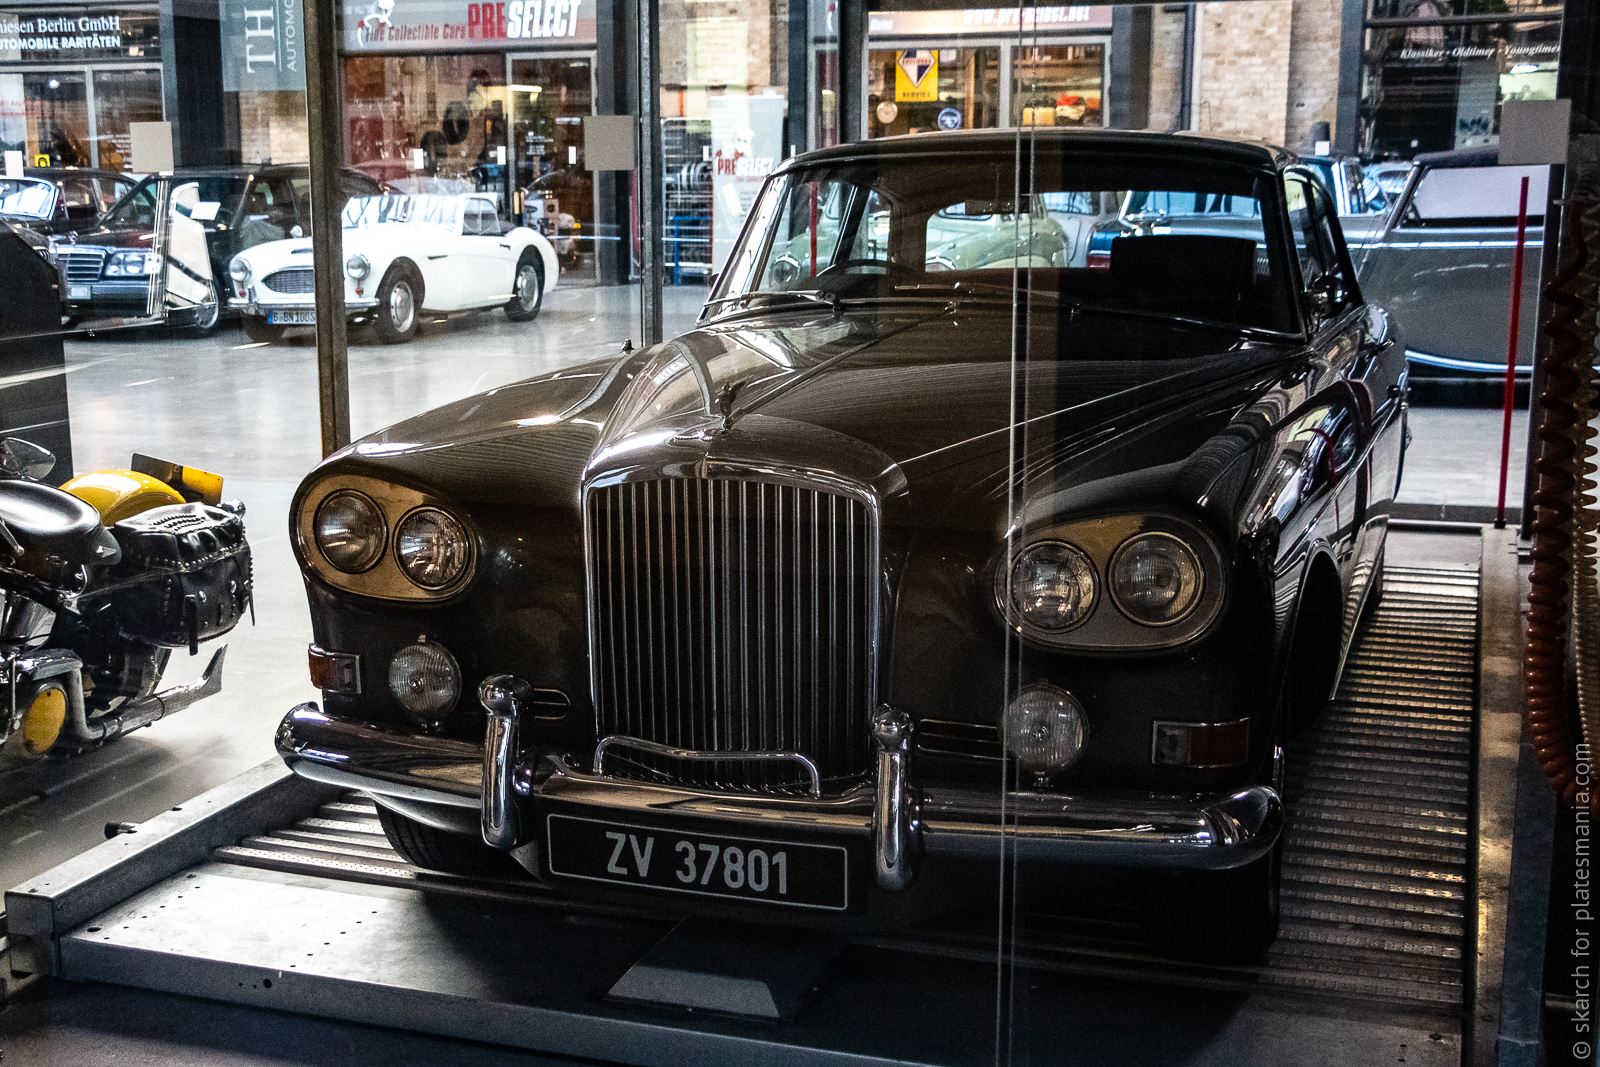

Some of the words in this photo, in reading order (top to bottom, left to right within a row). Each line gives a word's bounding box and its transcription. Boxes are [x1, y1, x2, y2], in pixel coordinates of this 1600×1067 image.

[37, 17, 76, 33] Berlin
[78, 15, 120, 32] GmbH
[388, 25, 440, 41] Collectible
[443, 23, 466, 40] Cars
[61, 33, 121, 48] RARITÄTEN
[1400, 48, 1444, 59] Klassiker
[1451, 45, 1495, 59] Oldtimer
[605, 831, 655, 878] ZV
[674, 839, 788, 895] 37801
